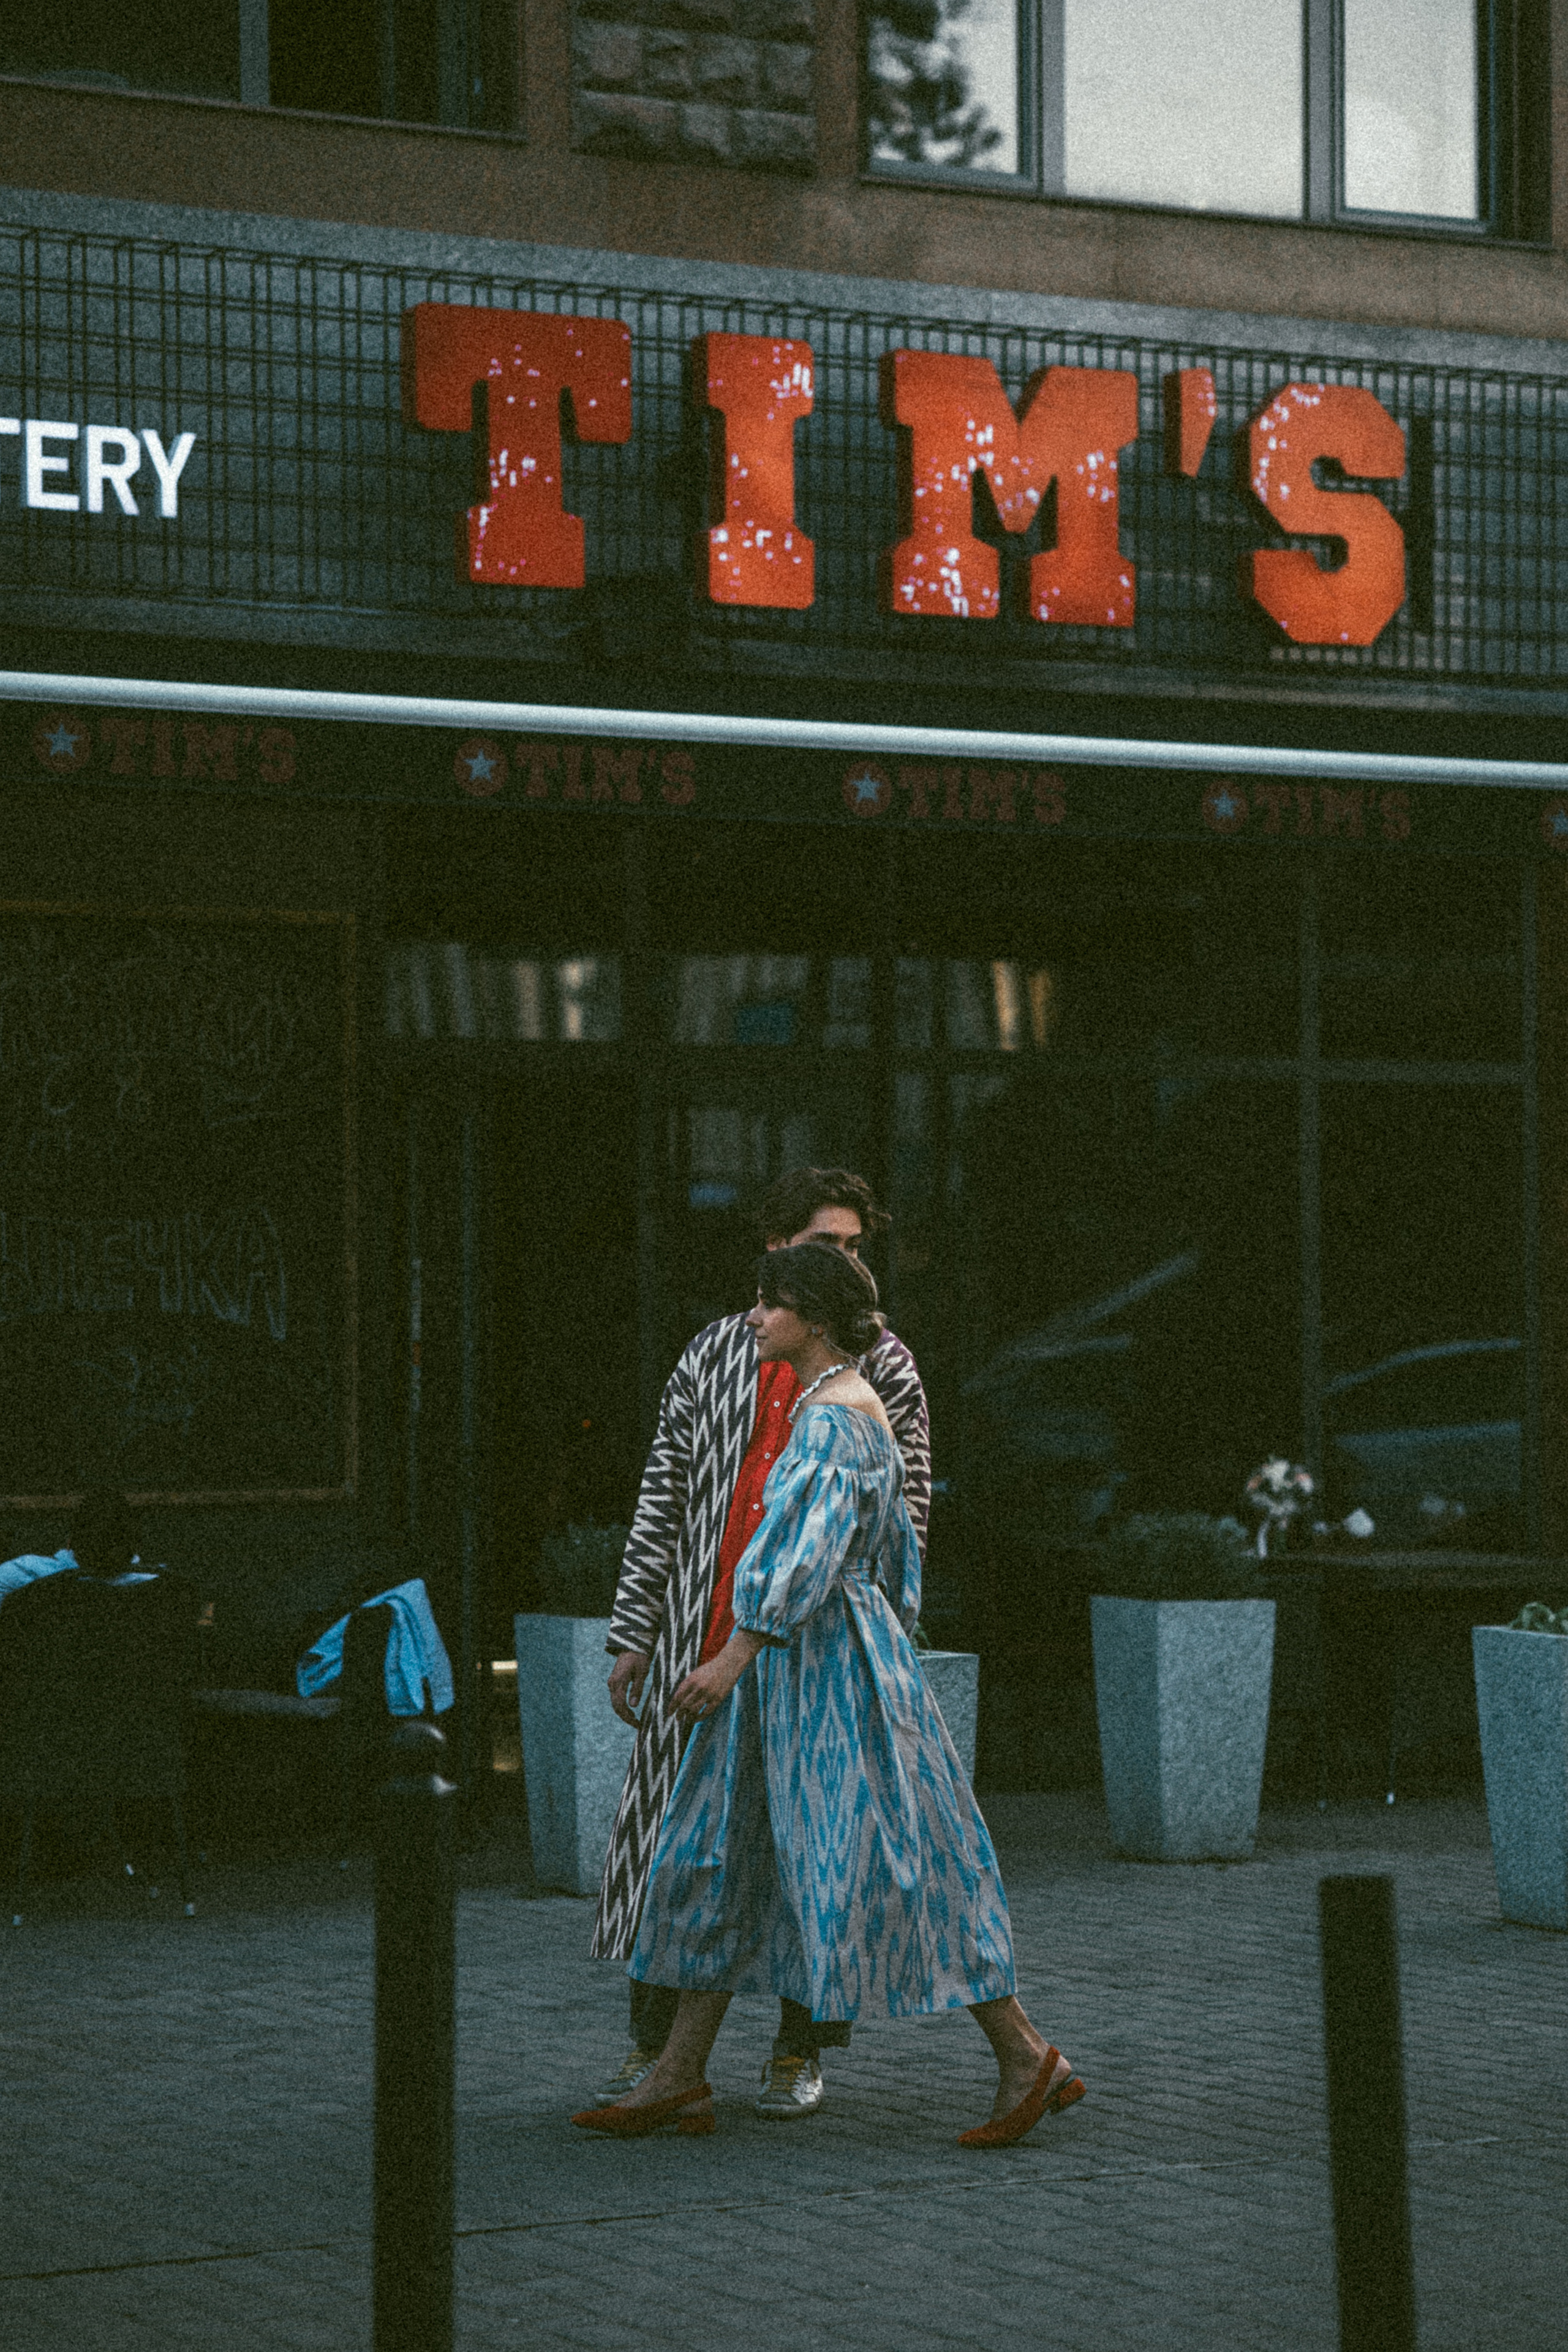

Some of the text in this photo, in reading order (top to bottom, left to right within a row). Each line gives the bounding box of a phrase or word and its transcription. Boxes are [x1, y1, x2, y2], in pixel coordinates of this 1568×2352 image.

[403, 301, 1407, 647] TIM'S
[99, 716, 298, 784] TIM'S
[515, 742, 696, 805] TIM'S
[897, 766, 1066, 825] TIM'S
[1254, 784, 1411, 842] TIM'S
